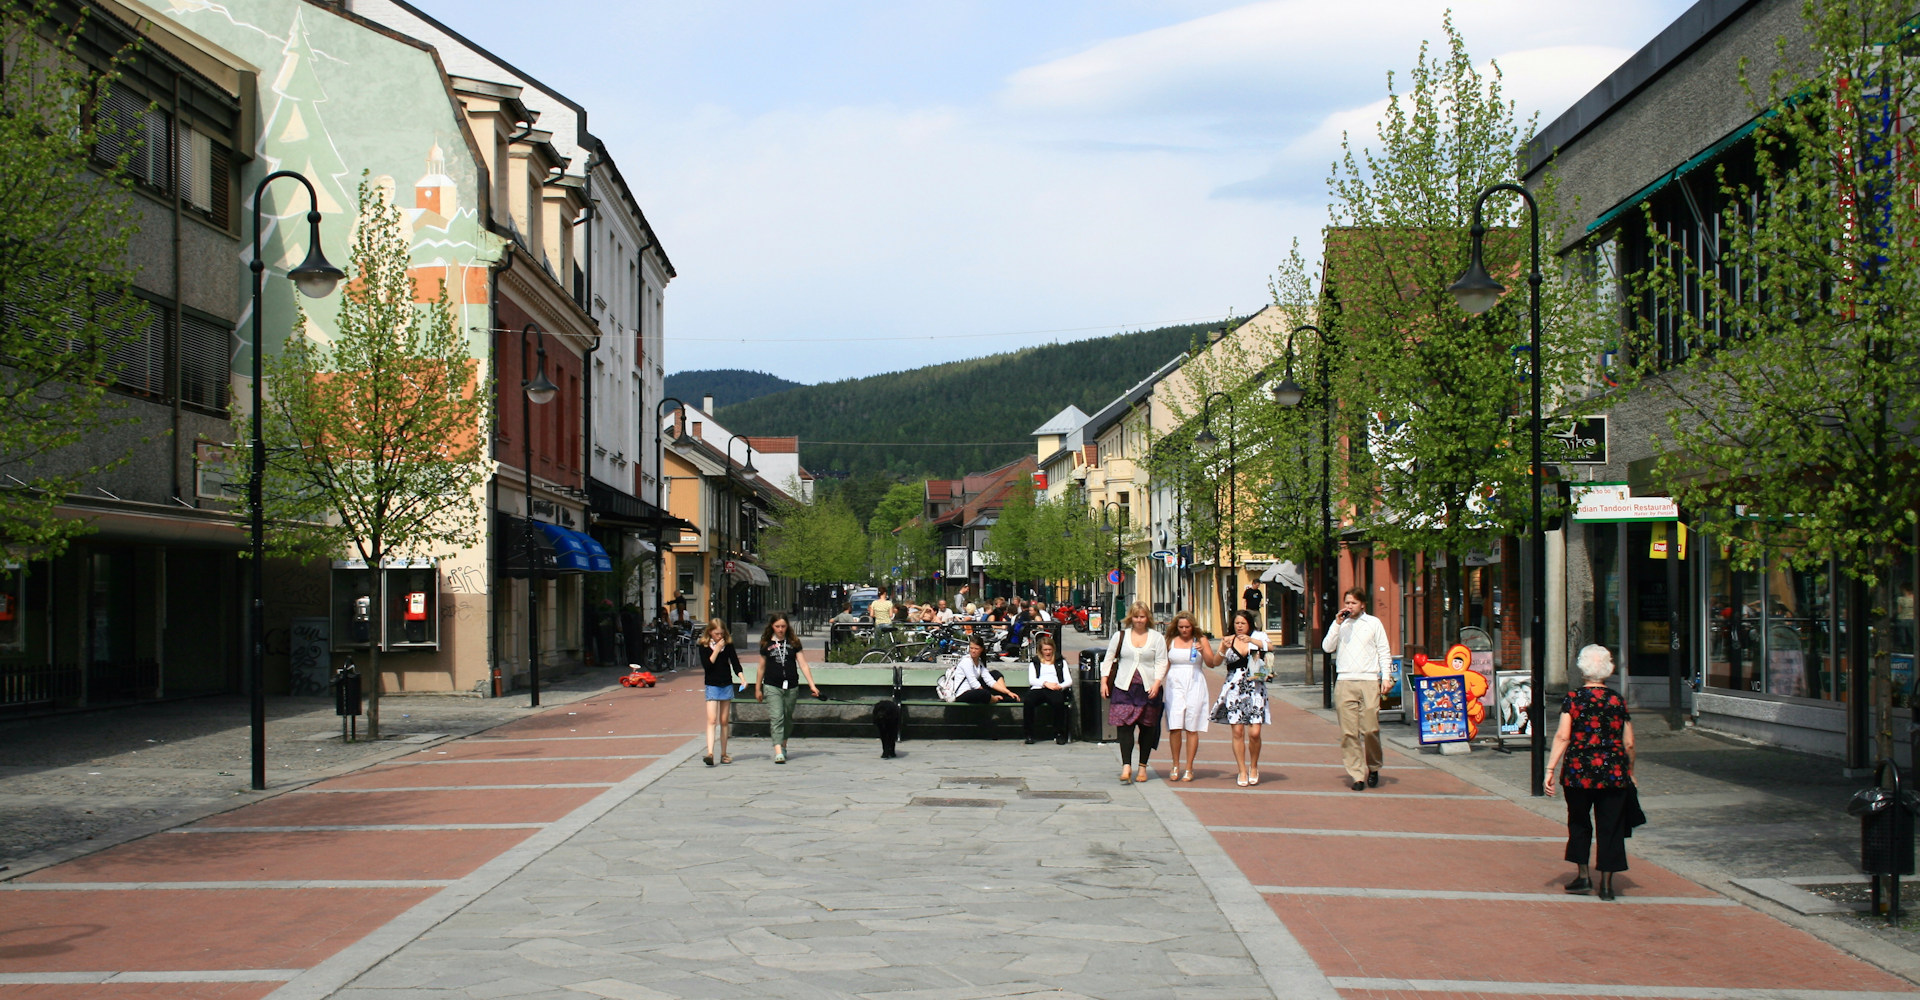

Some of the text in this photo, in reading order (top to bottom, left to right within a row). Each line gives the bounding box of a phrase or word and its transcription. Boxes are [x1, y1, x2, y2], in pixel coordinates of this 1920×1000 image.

[1577, 503, 1674, 513] ndian Tandoori Restaurant
